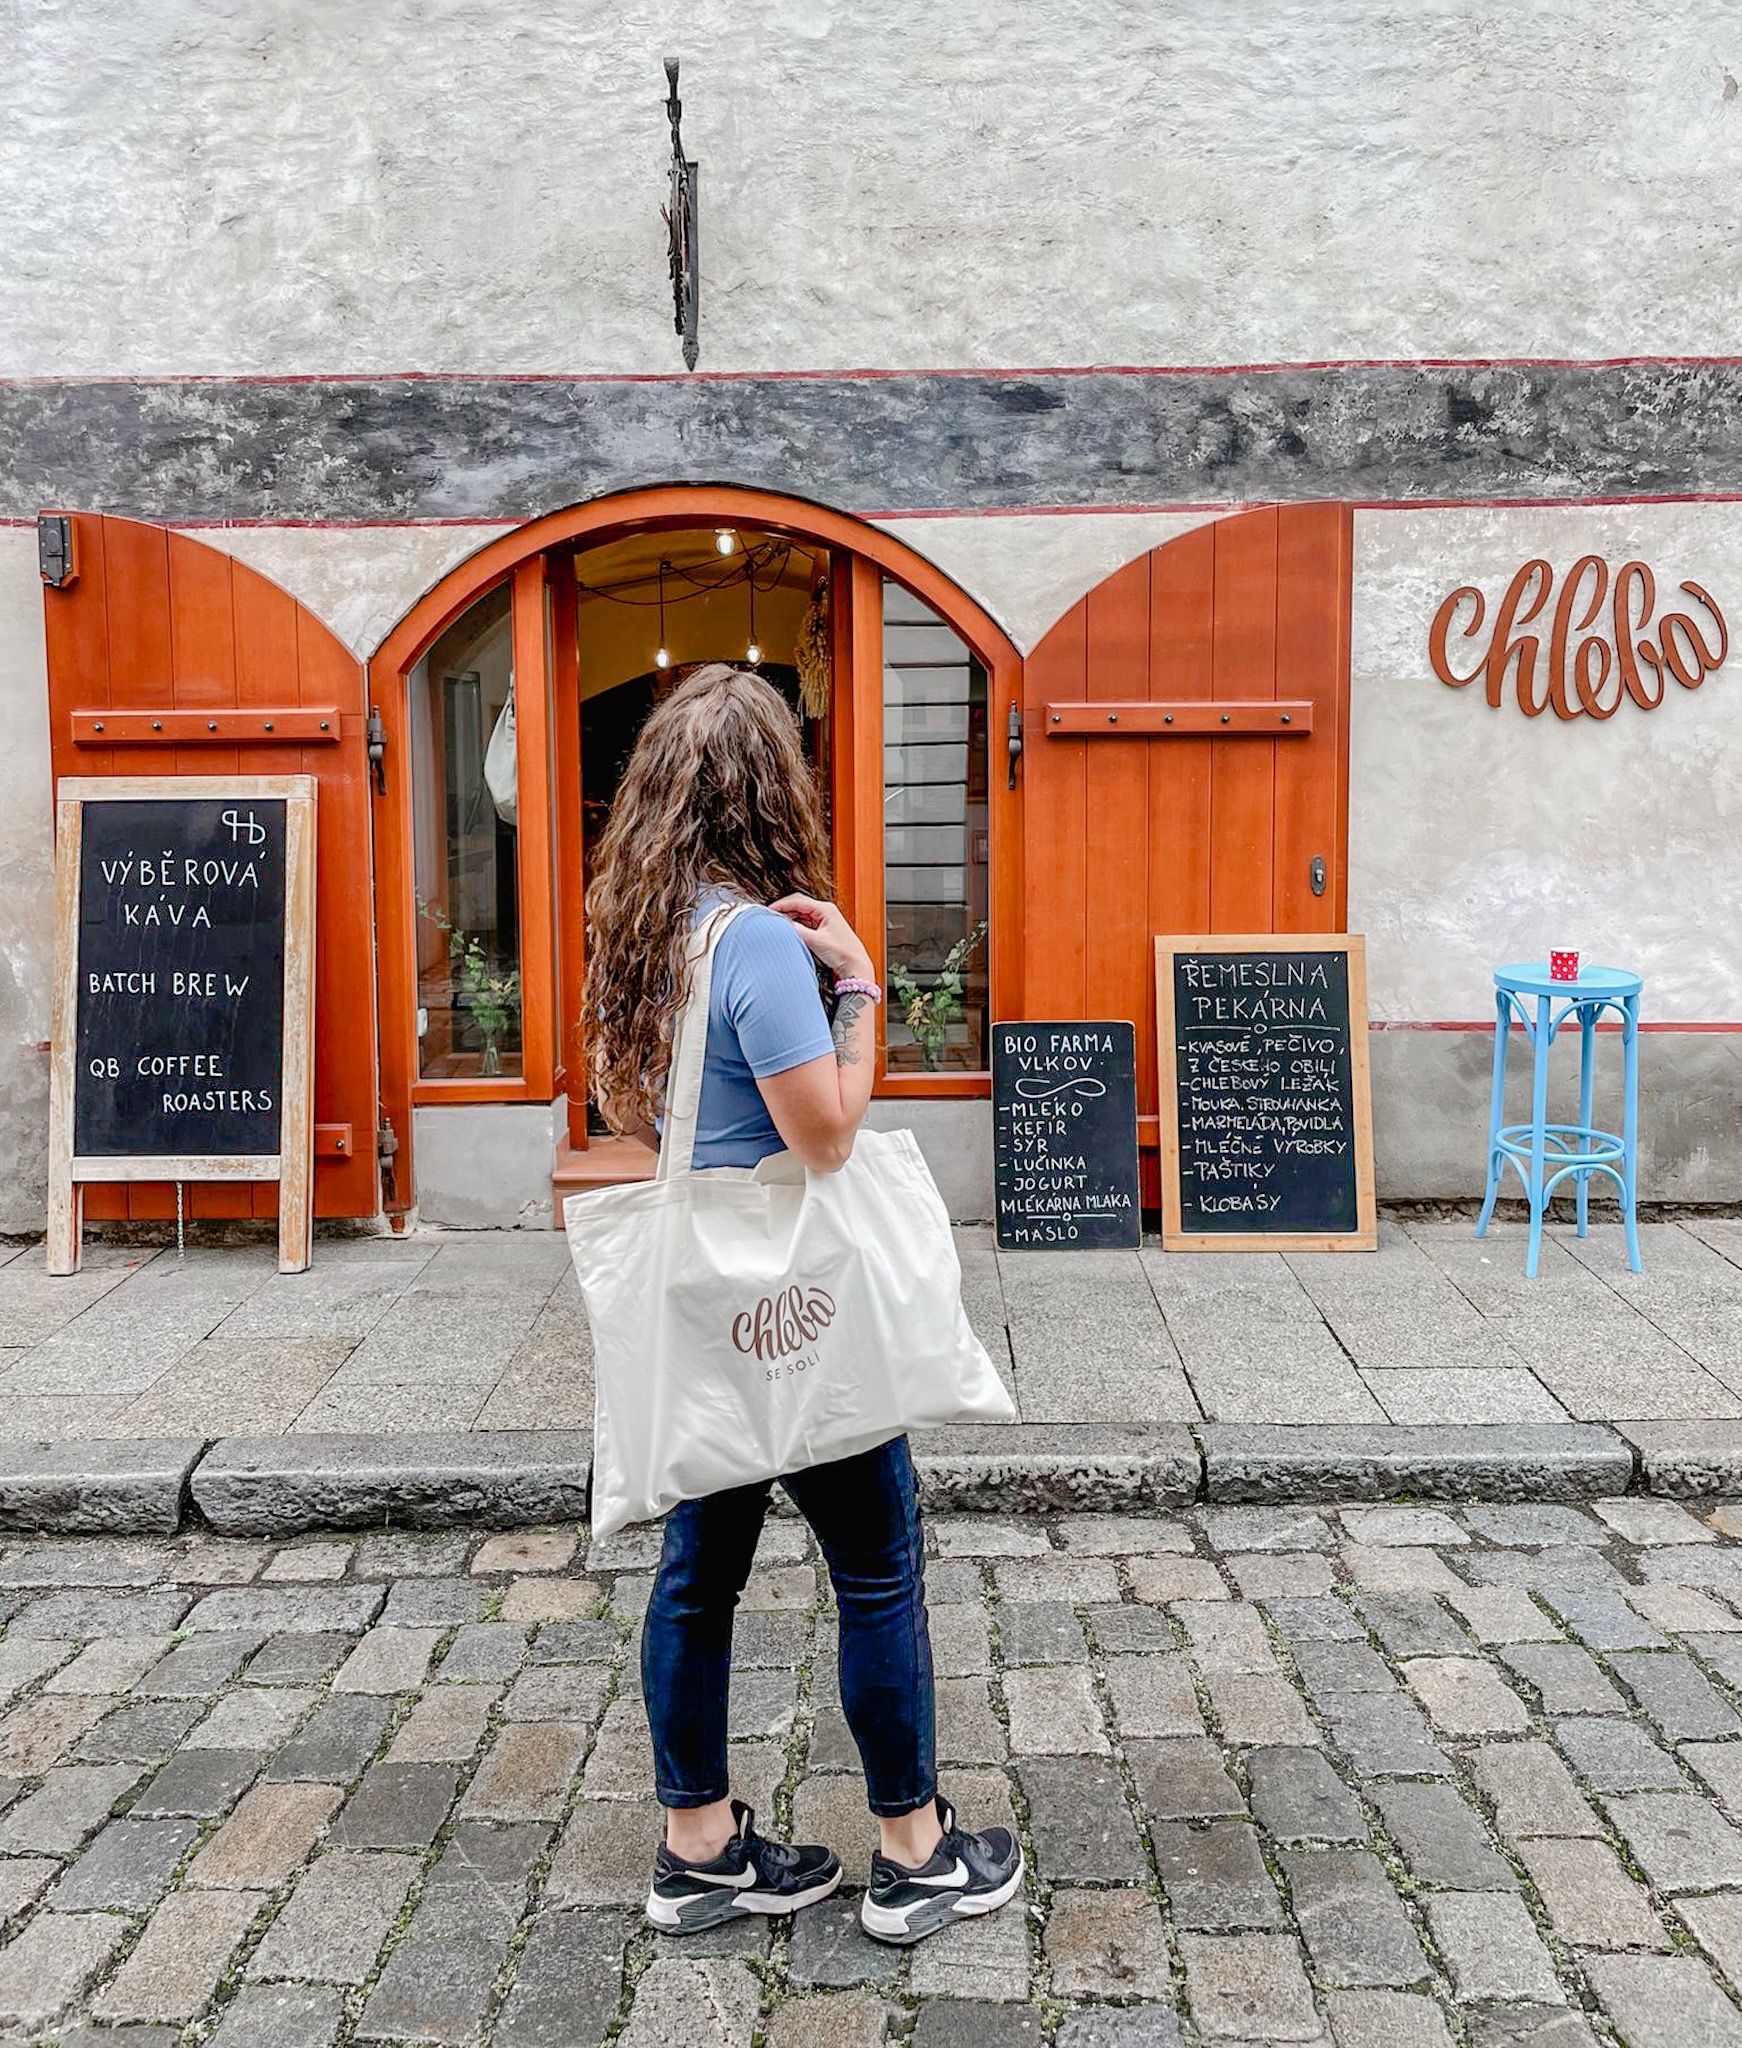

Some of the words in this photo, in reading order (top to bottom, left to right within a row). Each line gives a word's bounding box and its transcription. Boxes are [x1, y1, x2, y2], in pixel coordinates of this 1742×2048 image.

[101, 850, 268, 889] VÝBĚROVÁ
[124, 894, 212, 929] KÁVA
[88, 972, 156, 995] BATCH
[172, 973, 249, 997] BREW
[1192, 990, 1327, 1021] PEKÁRNA
[1005, 1036, 1037, 1054] BIO
[1050, 1034, 1114, 1053] FARMA
[89, 1057, 120, 1079] QB
[137, 1055, 223, 1077] COFFEE
[1018, 1056, 1093, 1071] VLKOV
[162, 1089, 273, 1114] ROASTERS
[1001, 1192, 1082, 1214] MLÉKÁRNA
[766, 1368, 781, 1381] SE
